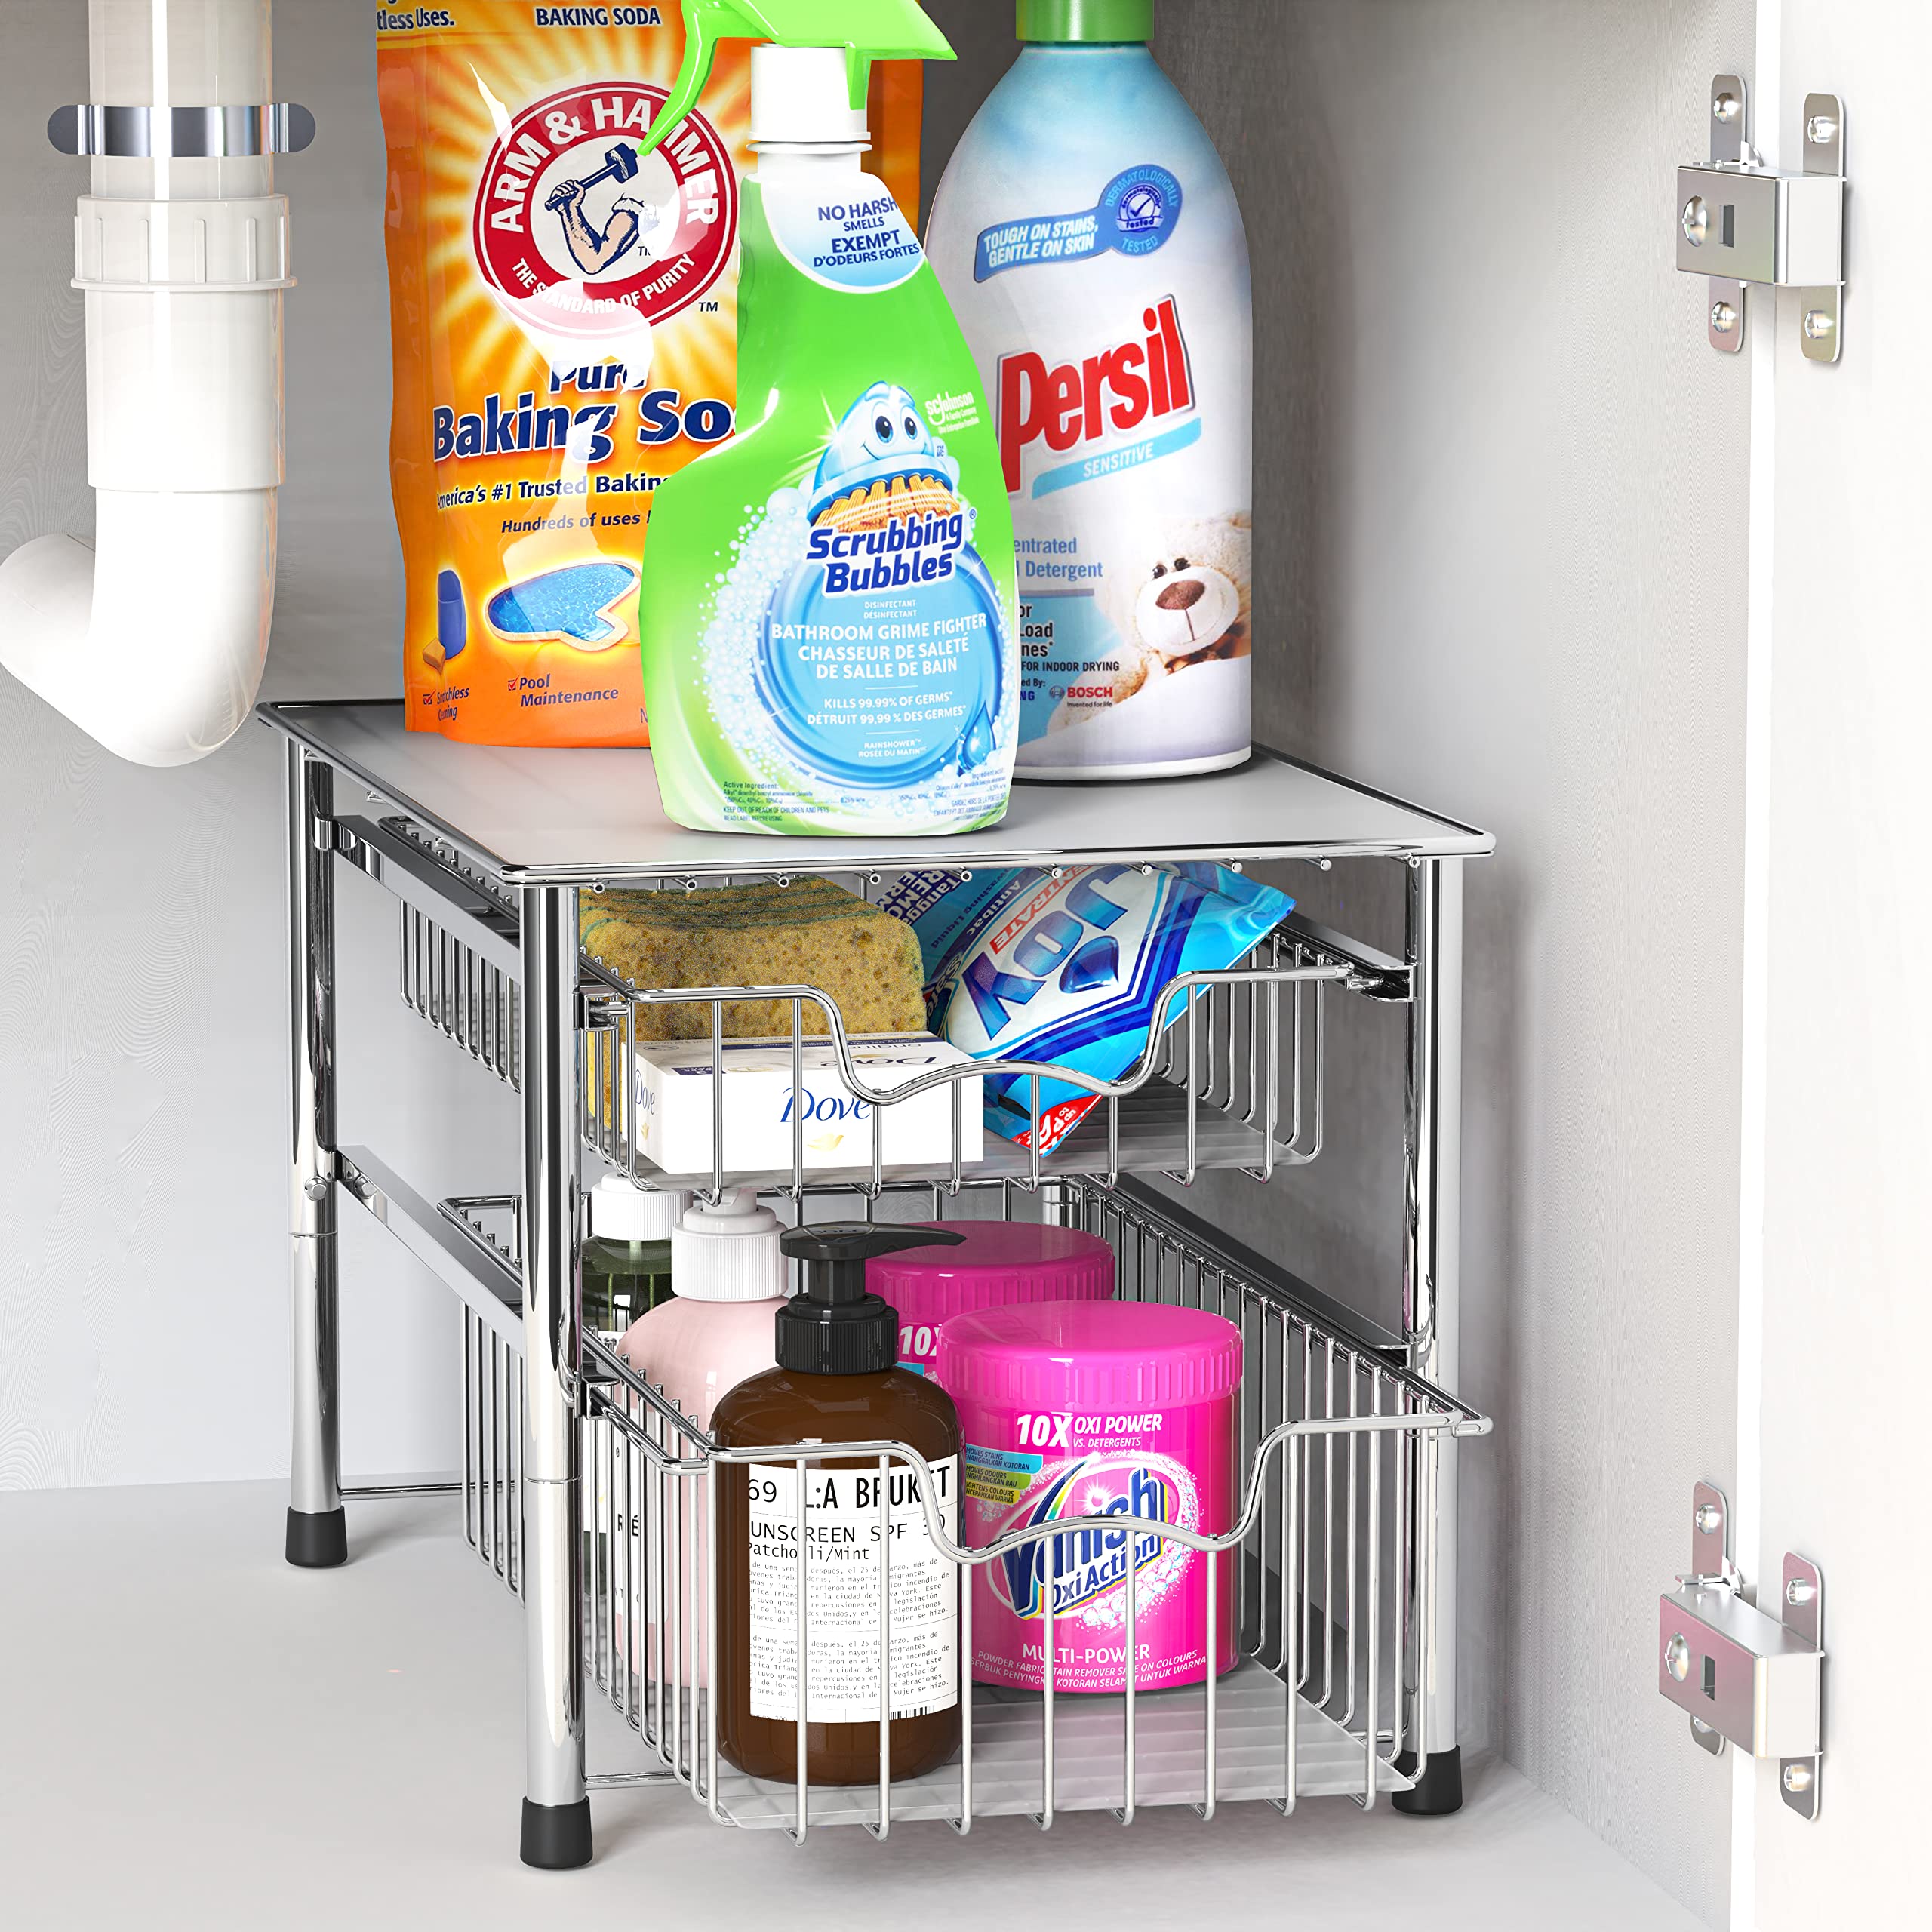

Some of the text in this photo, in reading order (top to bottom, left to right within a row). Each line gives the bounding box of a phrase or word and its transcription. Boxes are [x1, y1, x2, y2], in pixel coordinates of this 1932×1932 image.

[415, 8, 454, 28] Uses.
[535, 7, 661, 26] BAKING SODA
[490, 136, 548, 234] ARM
[1105, 168, 1178, 208] DERMATOLOGICALLY
[818, 205, 845, 221] NO
[844, 217, 885, 231] SMELLS
[832, 229, 900, 253] EXEMPT
[984, 226, 1028, 253] TOUGH
[1031, 223, 1051, 240] ON
[1122, 235, 1158, 253] TESTED
[814, 243, 920, 267] D'ODEURS FORTES
[989, 235, 1094, 268] GENTLE ON SKIN
[512, 257, 538, 289] THE
[619, 292, 641, 308] OF
[641, 252, 695, 300] PURITY
[1001, 299, 1190, 494] Persil
[434, 391, 734, 461] Baking So
[1084, 442, 1155, 478] SENSITIVE
[492, 483, 512, 500] #1
[519, 476, 586, 499] Trusted
[501, 515, 574, 533] Hundreds
[580, 513, 595, 527] of
[601, 515, 640, 526] uses
[806, 512, 963, 560] Scrubbing
[825, 550, 953, 593] Bubbles
[1026, 561, 1103, 581] Detergent
[863, 609, 917, 620] DÉSINFECTANT
[864, 600, 916, 609] DISINFECTANT
[771, 612, 987, 641] BATHROOM GRIME FIGHTER
[798, 636, 970, 662] CHASSEUR DE SALETÉ
[816, 657, 958, 679] DE SALLE DE BAIN
[1021, 661, 1119, 672] FOR INDOOR DRYING
[520, 675, 550, 690] Pool
[1067, 686, 1113, 698] BOSCH
[521, 687, 619, 707] Maintenance
[824, 697, 856, 709] KILLS
[858, 696, 897, 709] 99.99%
[899, 695, 915, 707] OF
[808, 711, 858, 726] DÉTRUIT
[903, 712, 923, 722] DES
[967, 880, 1020, 936] Antibac
[961, 866, 1129, 1040] JOY
[780, 1087, 872, 1123] Dove
[1017, 1413, 1163, 1448] 10X OXI POWER
[1073, 1435, 1141, 1447] VS. DETERGENTS
[985, 1451, 1004, 1460] STAINS
[1004, 1461, 1030, 1470] KOTORAN
[985, 1469, 1006, 1479] ODOURS
[989, 1487, 1014, 1497] COLOURS
[996, 1494, 1014, 1503] WARNA
[925, 1583, 941, 1592] Este
[978, 1651, 1014, 1669] POWDER
[1075, 1668, 1115, 1678] REMOVER
[1140, 1662, 1154, 1672] ON
[1156, 1650, 1198, 1668] COLOURS
[1057, 1678, 1097, 1688] KOTORAN
[1100, 1675, 1139, 1688] SELAMT
[1140, 1669, 1171, 1683] UNTUK
[1173, 1656, 1207, 1675] WARNA
